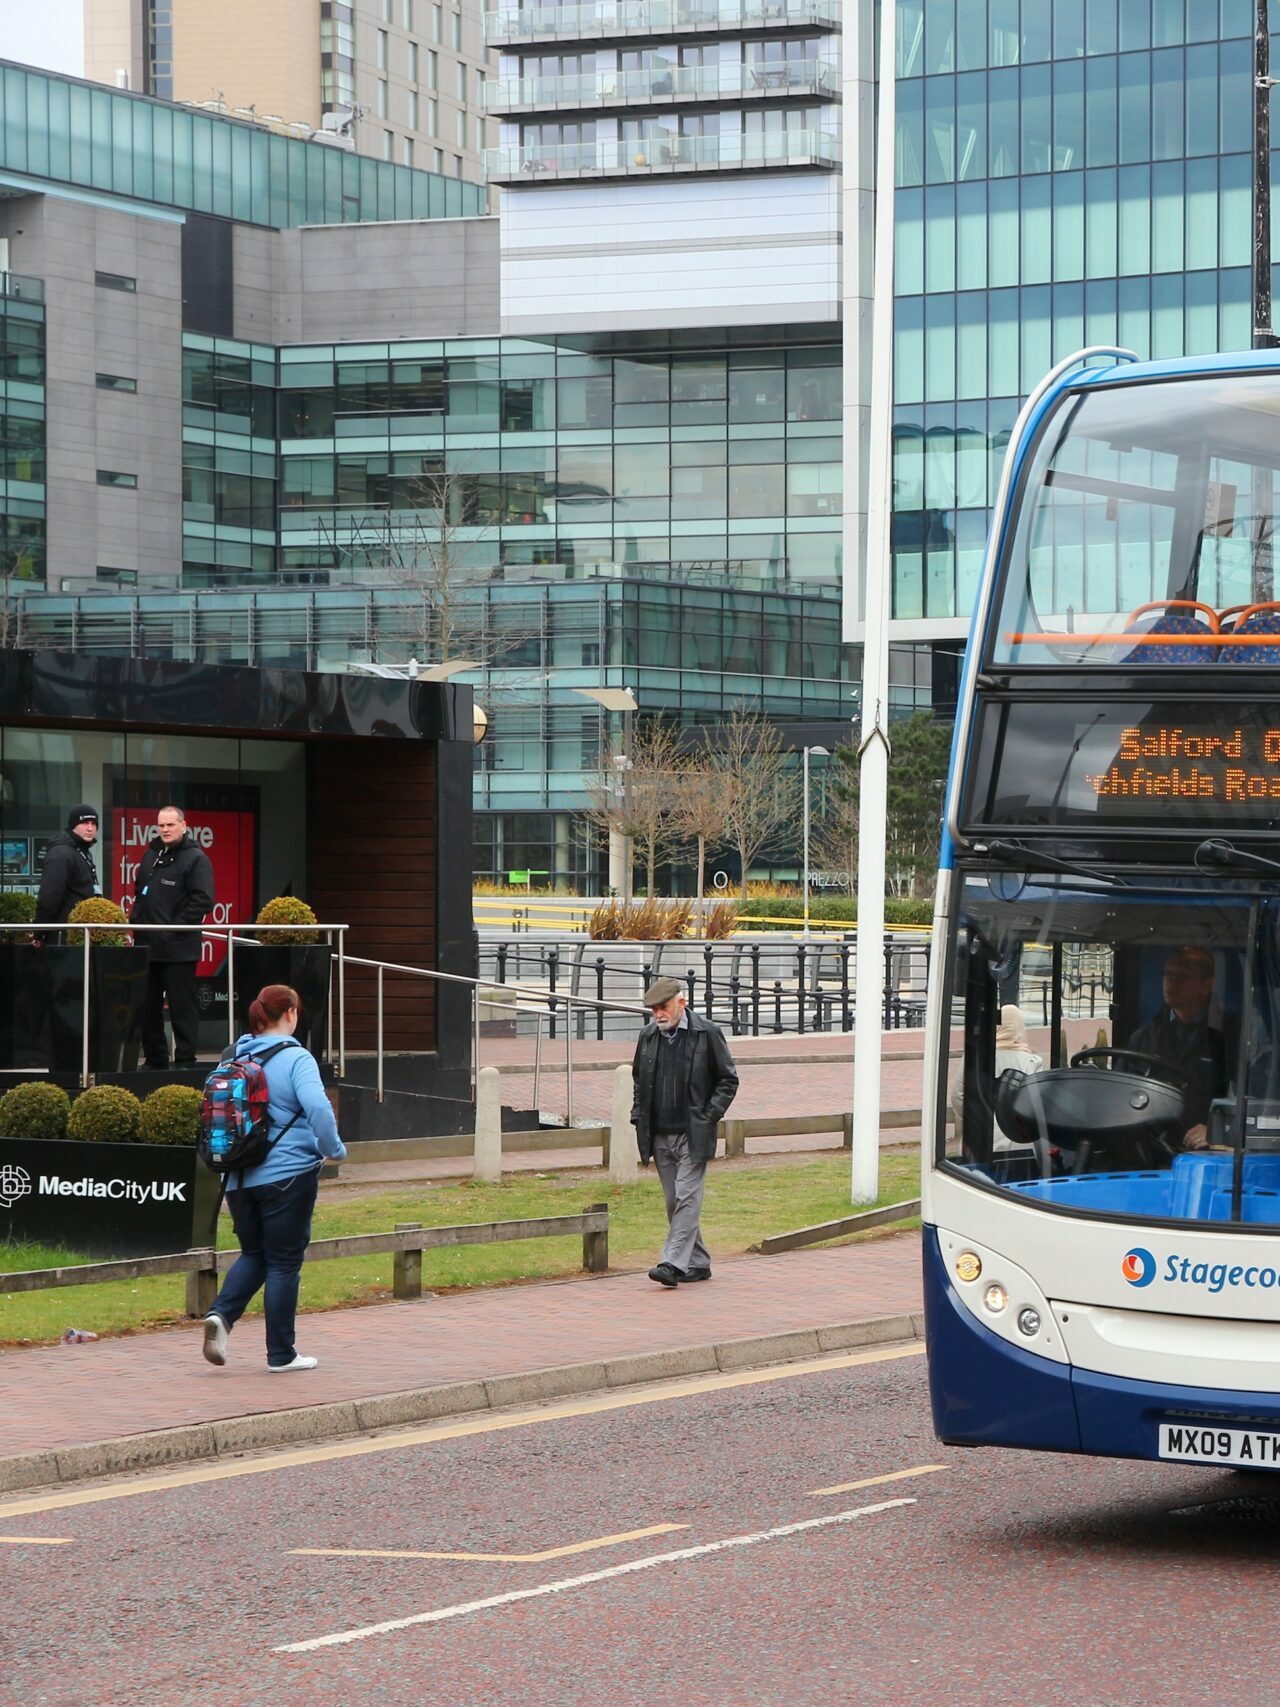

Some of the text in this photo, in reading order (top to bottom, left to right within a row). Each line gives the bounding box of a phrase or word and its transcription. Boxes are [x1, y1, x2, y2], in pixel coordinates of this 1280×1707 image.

[1120, 728, 1242, 760] Salford
[1086, 767, 1214, 796] chfields
[120, 817, 161, 846] Live
[806, 872, 849, 887] PREZZO
[38, 1175, 187, 1205] MediaCityUK
[1167, 1428, 1232, 1457] MX09
